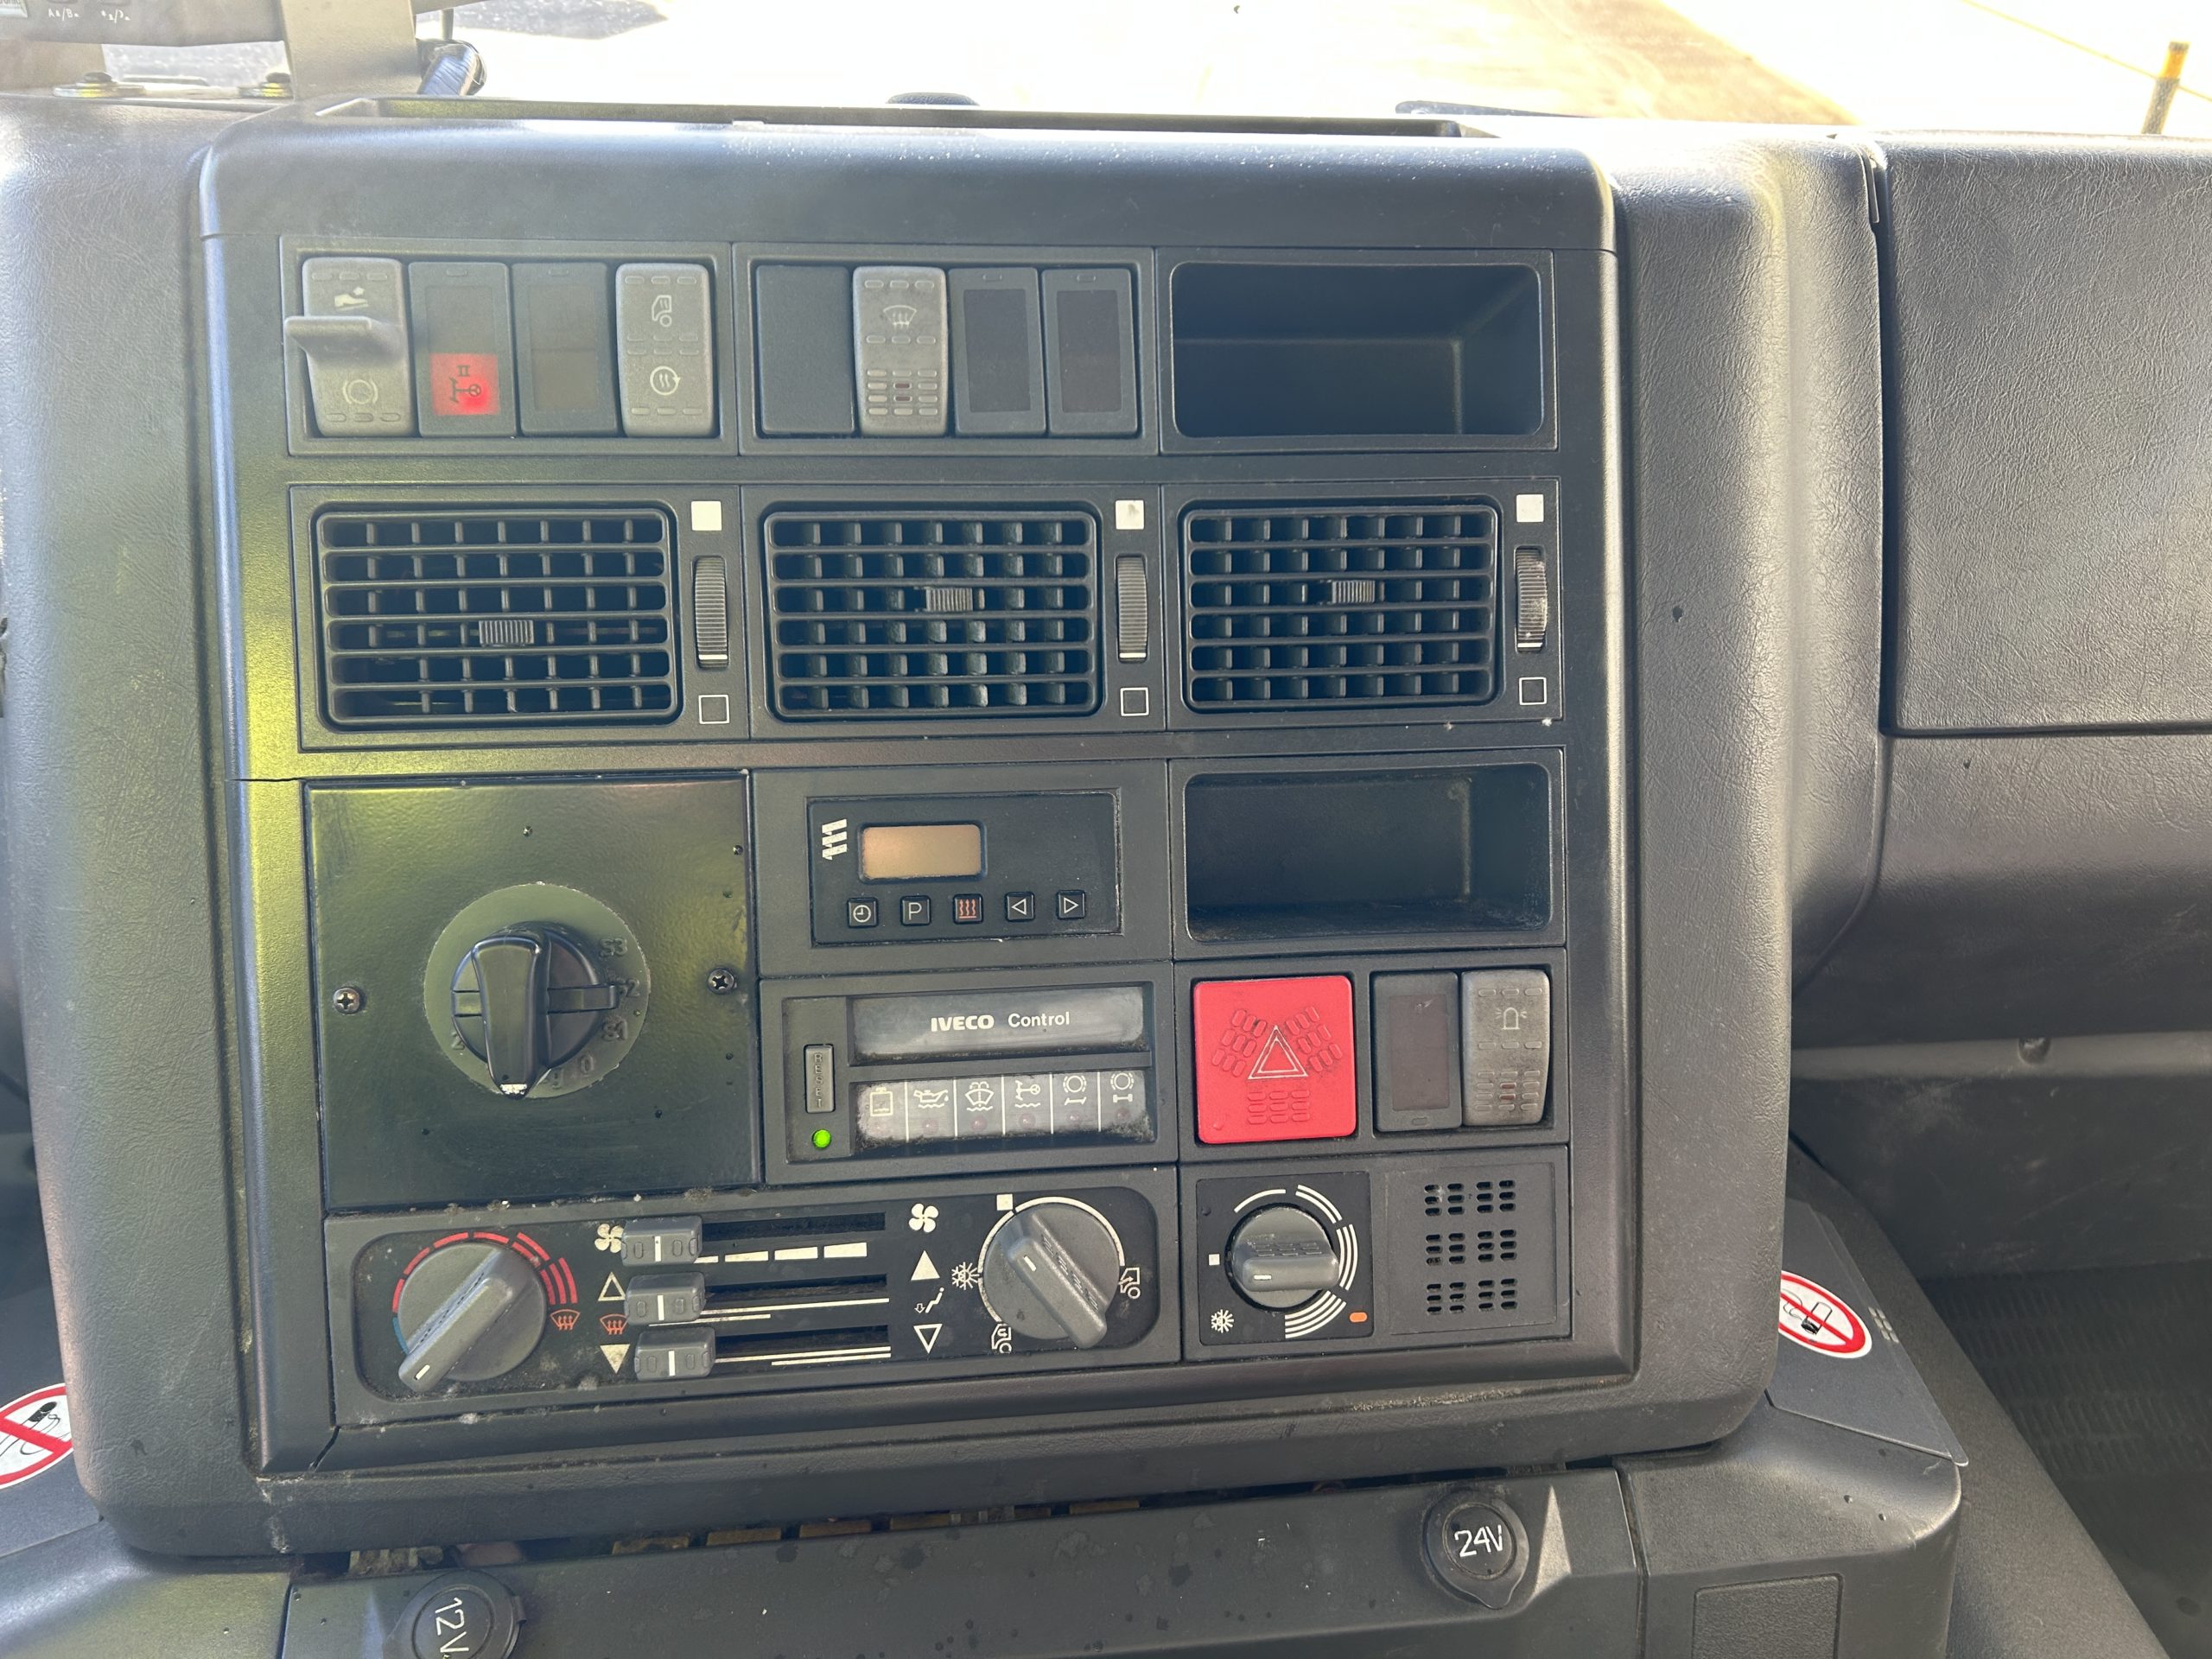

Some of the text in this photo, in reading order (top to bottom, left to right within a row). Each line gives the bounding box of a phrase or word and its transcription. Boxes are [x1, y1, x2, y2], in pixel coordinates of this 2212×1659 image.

[908, 902, 923, 921] P
[931, 1011, 1071, 1033] IVECO Control
[814, 1052, 824, 1109] RESET
[1454, 1524, 1503, 1558] 24V
[435, 1597, 470, 1653] 12V
